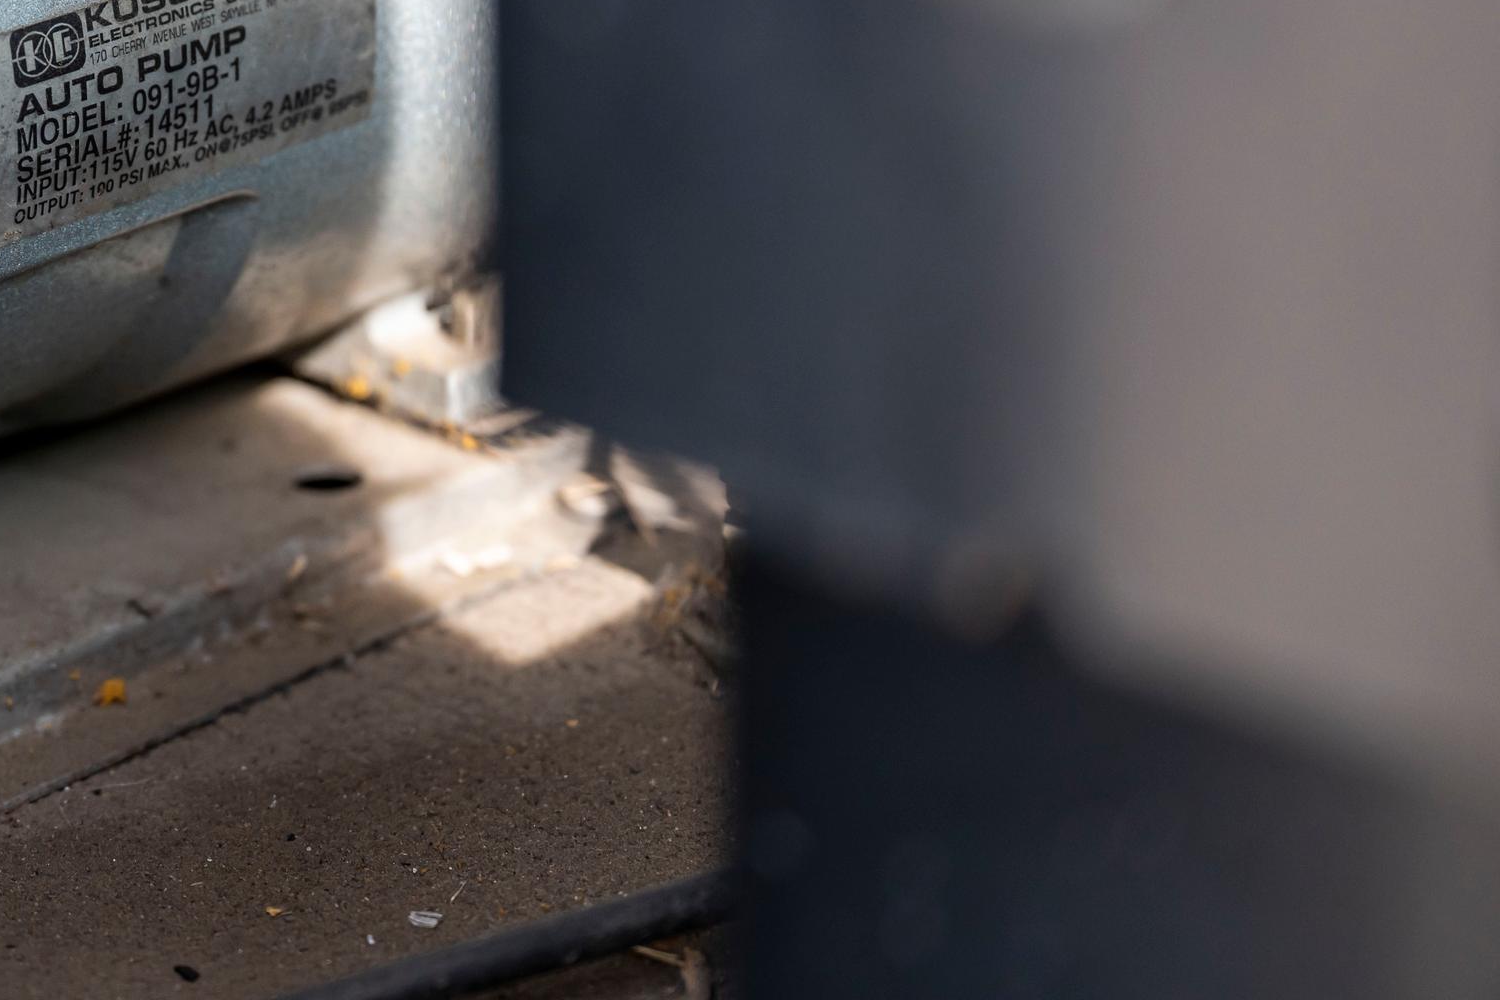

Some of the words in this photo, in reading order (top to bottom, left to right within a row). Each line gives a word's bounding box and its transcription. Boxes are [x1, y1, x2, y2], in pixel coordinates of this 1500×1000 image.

[17, 66, 123, 123] AUTO
[137, 25, 246, 82] PUMP
[90, 49, 107, 65] 170
[112, 36, 147, 58] CHERRY
[153, 23, 187, 45] AVENUE
[190, 14, 216, 32] WEST
[16, 101, 123, 154] MODEL:
[133, 57, 240, 115] 091-9B-1
[144, 139, 167, 161] 60
[173, 129, 198, 152] Hz
[204, 114, 238, 142] AC,
[245, 101, 274, 124] 4.2
[279, 78, 337, 115] AMPS
[14, 189, 84, 224] OUTPUT:
[119, 168, 143, 188] PSI
